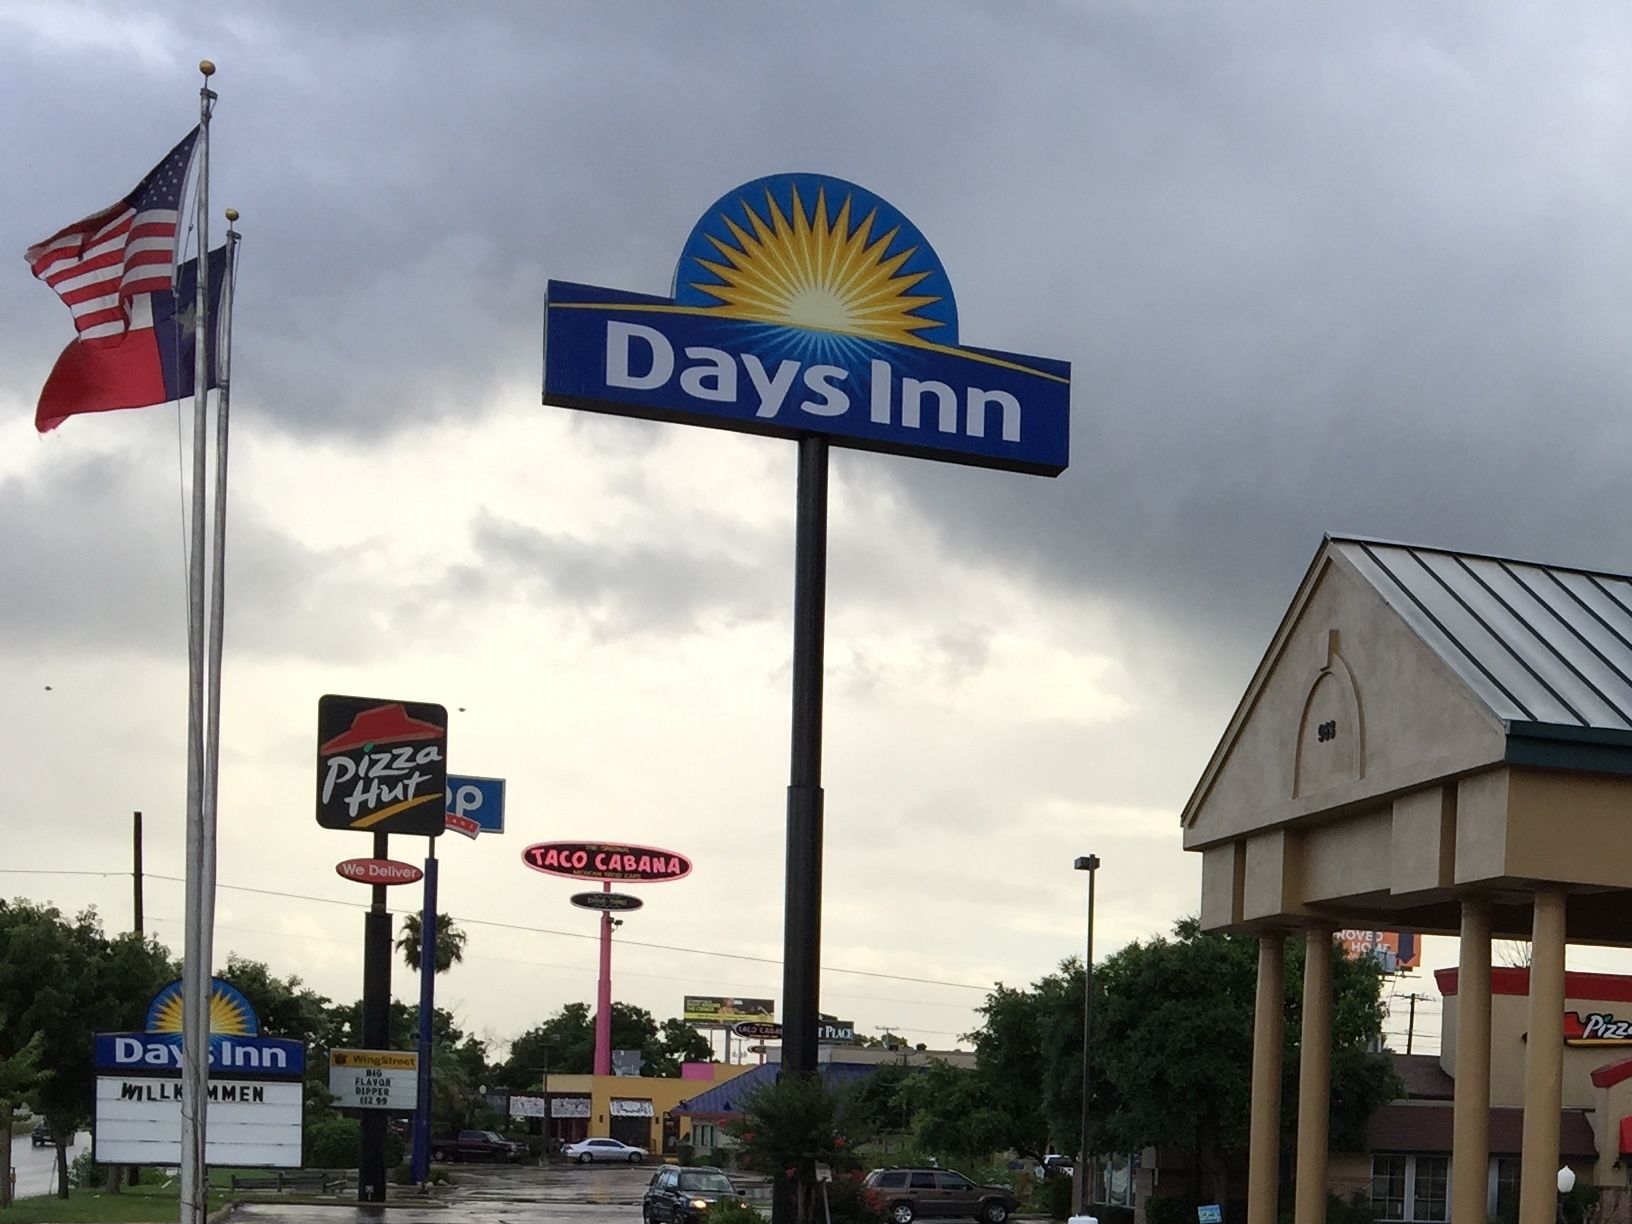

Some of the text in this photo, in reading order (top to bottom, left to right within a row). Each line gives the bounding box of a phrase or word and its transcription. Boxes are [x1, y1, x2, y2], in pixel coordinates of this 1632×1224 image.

[605, 319, 1022, 443] Days Inn
[322, 742, 443, 805] Pizza
[344, 772, 433, 817] Hut
[342, 863, 418, 879] We Deliver
[531, 848, 681, 874] TACO CABANA
[221, 1041, 287, 1068] Inn
[352, 1055, 416, 1067] WingStreet
[355, 1078, 392, 1087] FLAVOR
[365, 1069, 383, 1077] BIG
[121, 1082, 264, 1103] WILLKMMEN
[355, 1087, 390, 1096] DIPPER
